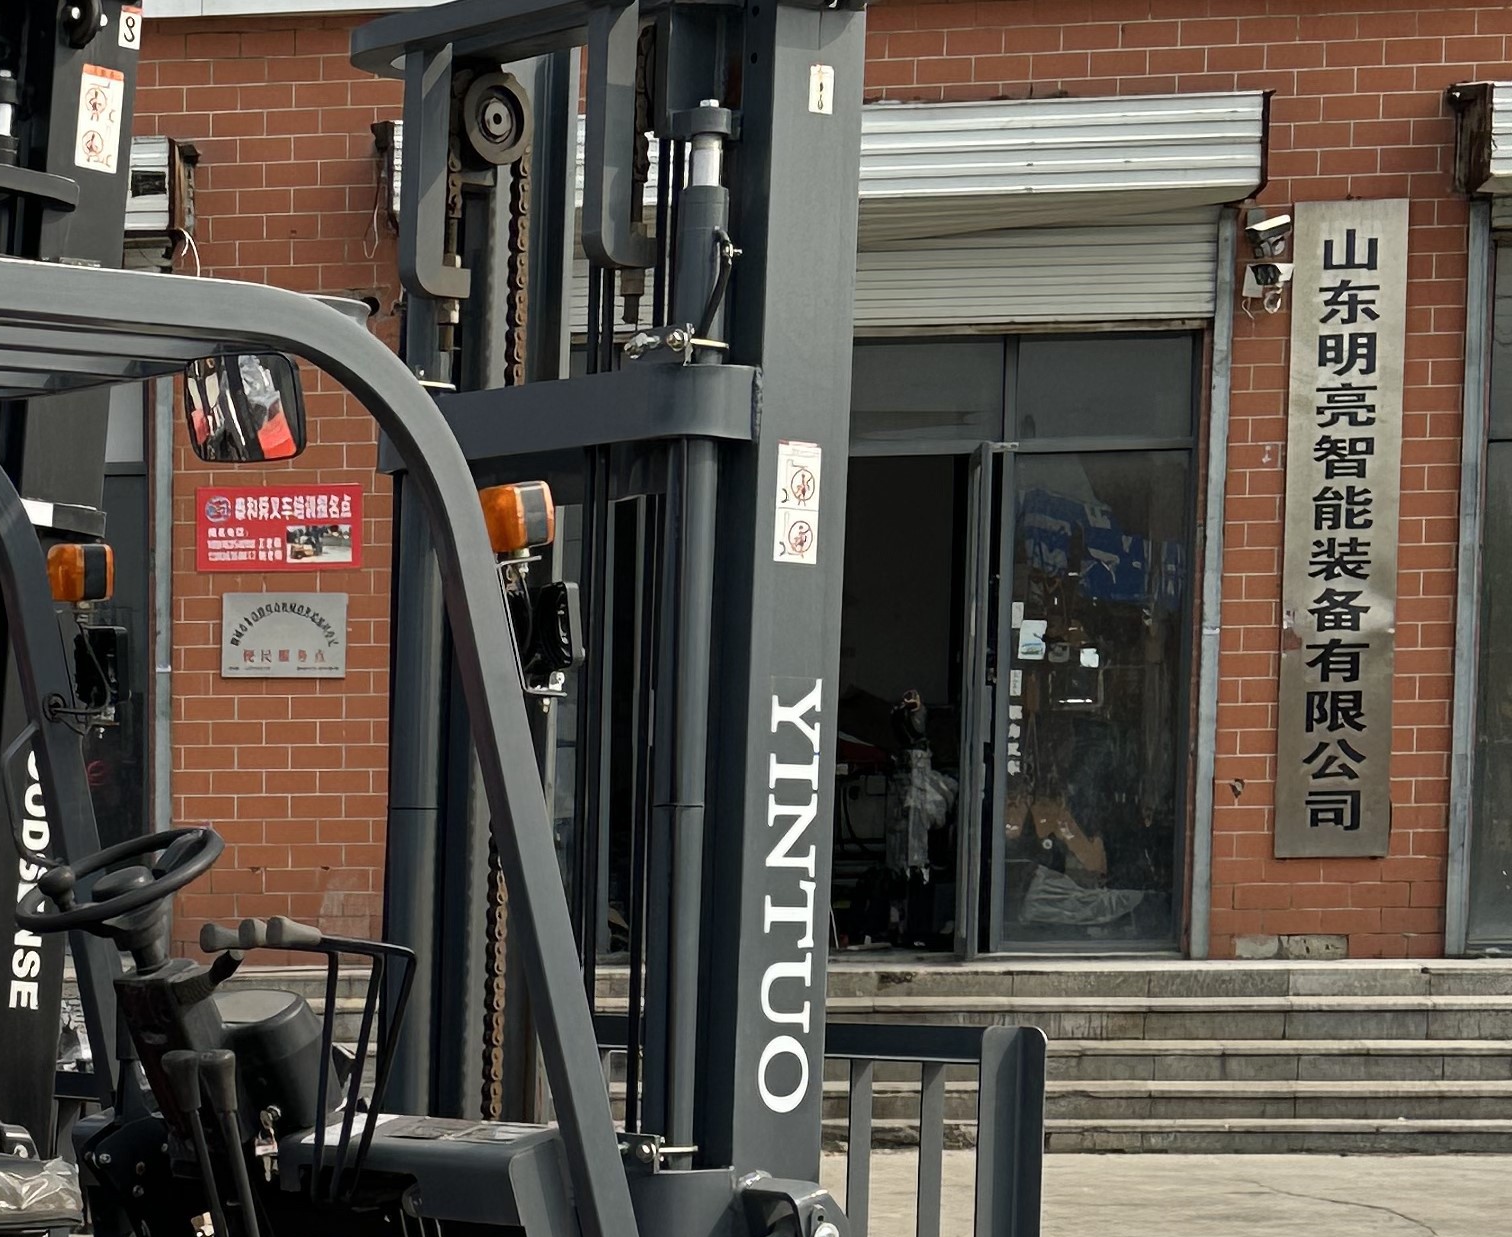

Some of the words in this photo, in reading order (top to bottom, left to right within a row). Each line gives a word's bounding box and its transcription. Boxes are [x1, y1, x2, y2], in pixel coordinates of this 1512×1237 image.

[1302, 228, 1380, 832] 山东明亮智能装备有限公司
[757, 678, 823, 1114] YINTUO
